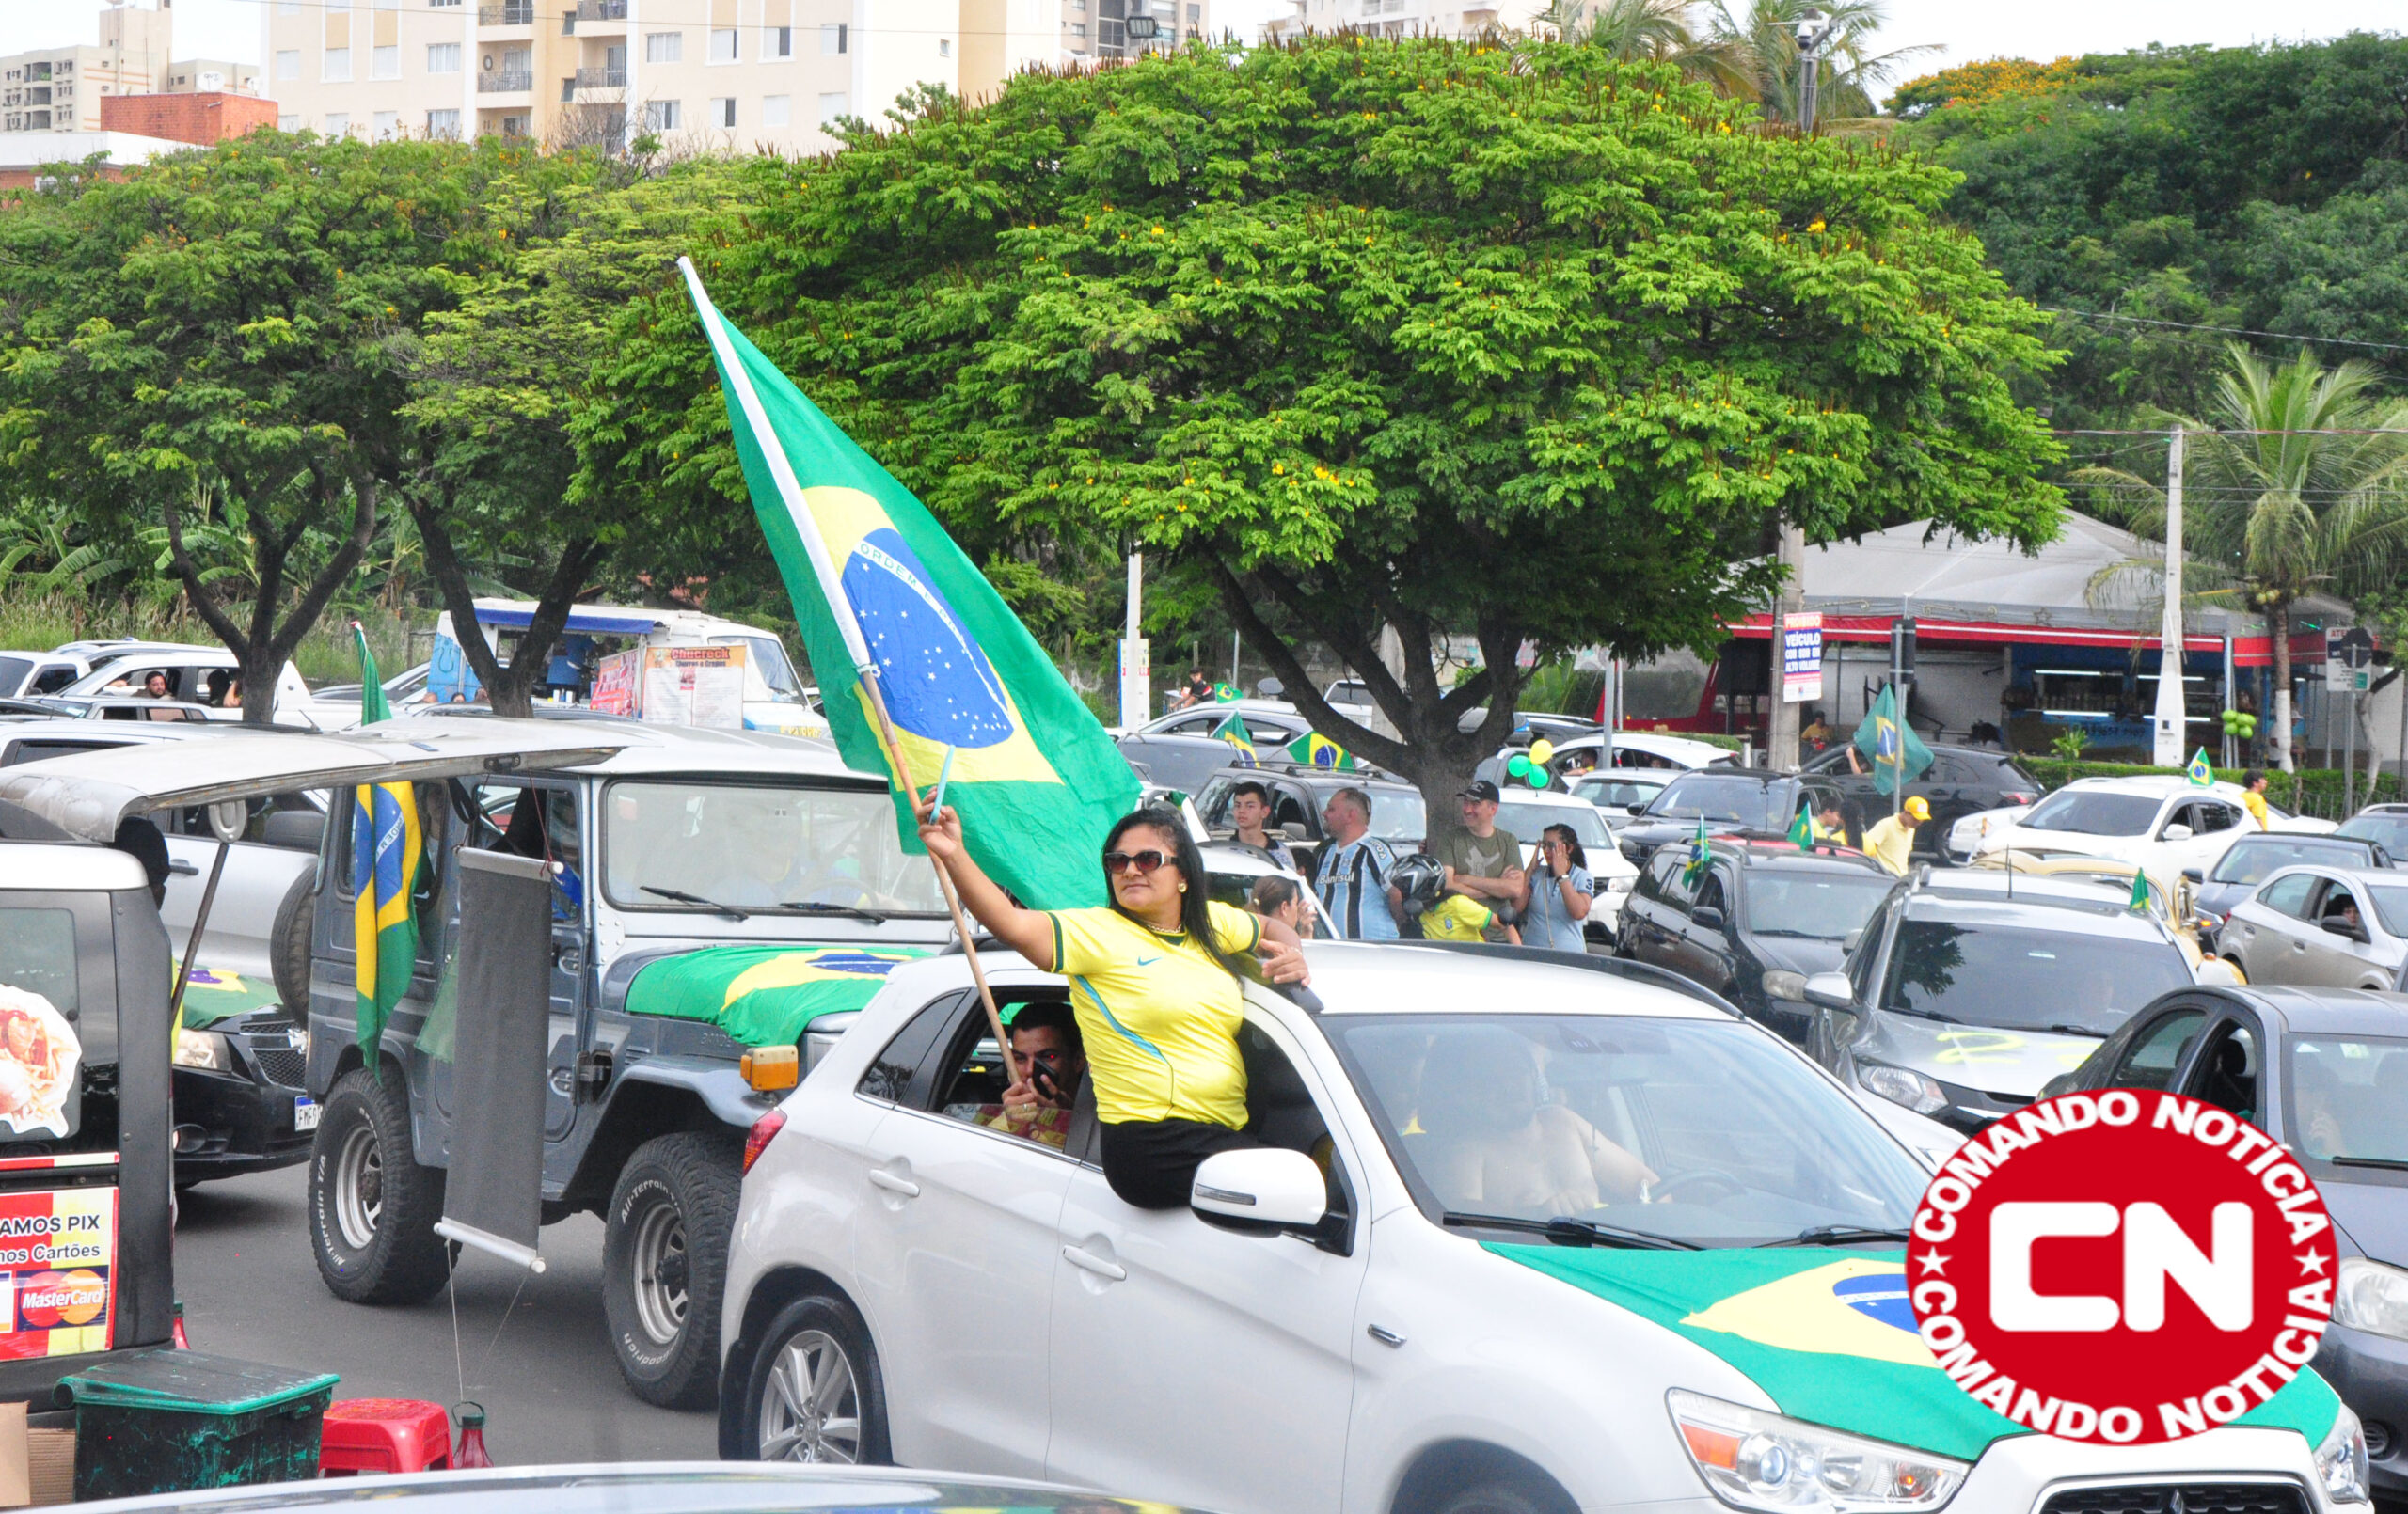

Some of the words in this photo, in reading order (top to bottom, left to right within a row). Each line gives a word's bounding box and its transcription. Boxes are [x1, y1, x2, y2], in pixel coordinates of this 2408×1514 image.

[860, 544, 917, 587] ORDEM
[1785, 615, 1821, 628] PROIBIDO
[1785, 631, 1821, 647] VEÍCULO
[1785, 660, 1798, 672] ALTO
[1798, 659, 1821, 671] VOLUME
[1319, 871, 1354, 884] Banrisul
[1585, 878, 1593, 891] 3
[621, 1179, 669, 1225] All-Terrain
[0, 1216, 61, 1236] AMOS
[68, 1214, 100, 1231] PIX
[34, 1243, 101, 1260] Cartões
[22, 1287, 103, 1309] MasterCard
